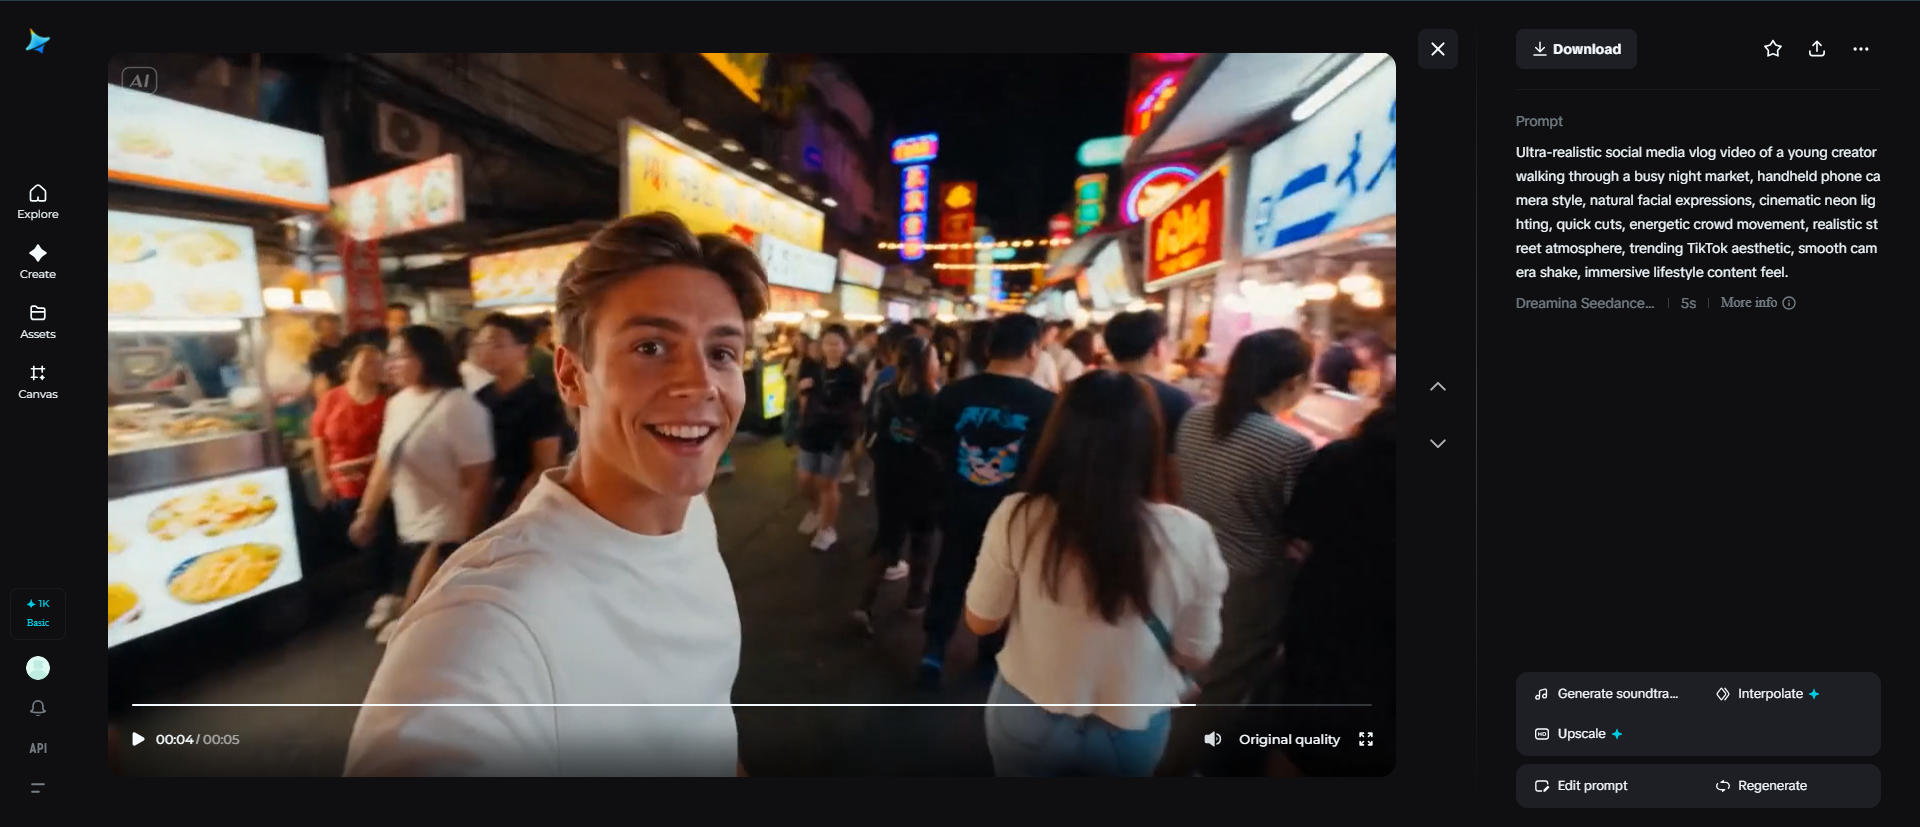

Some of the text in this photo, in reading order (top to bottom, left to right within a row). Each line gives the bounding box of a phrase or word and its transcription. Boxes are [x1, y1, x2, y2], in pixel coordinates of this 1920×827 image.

[1553, 43, 1621, 55] Download
[1516, 116, 1563, 129] Prompt
[1516, 146, 1877, 160] Ultra-realistic social media vlog video of a young creator
[1516, 170, 1881, 184] walking through a busy night market, handheld phone ca
[1516, 194, 1875, 208] mera style, natural facial expressions, cinematic neon lig
[17, 209, 59, 221] Explore
[1516, 218, 1878, 232] hting, quick cuts, energetic crowd movement, realistic st
[1516, 242, 1877, 256] reet atmosphere, trending TikTok aesthetic, smooth cam
[19, 269, 56, 279] Create
[1516, 266, 1788, 280] era shake, immersive lifestyle content feel.
[1516, 297, 1577, 309] Dreamina
[1681, 297, 1696, 309] 5s
[1721, 297, 1777, 308] More info
[20, 329, 56, 339] Assets
[18, 389, 58, 399] Canvas
[1558, 688, 1613, 699] Generate
[1738, 688, 1803, 701] Interpolate
[203, 734, 240, 745] 00:05
[1239, 733, 1341, 747] Original quality
[1558, 728, 1606, 741] Upscale
[29, 743, 47, 753] API
[1558, 780, 1628, 793] Edit prompt
[1738, 780, 1807, 793] Regenerate
